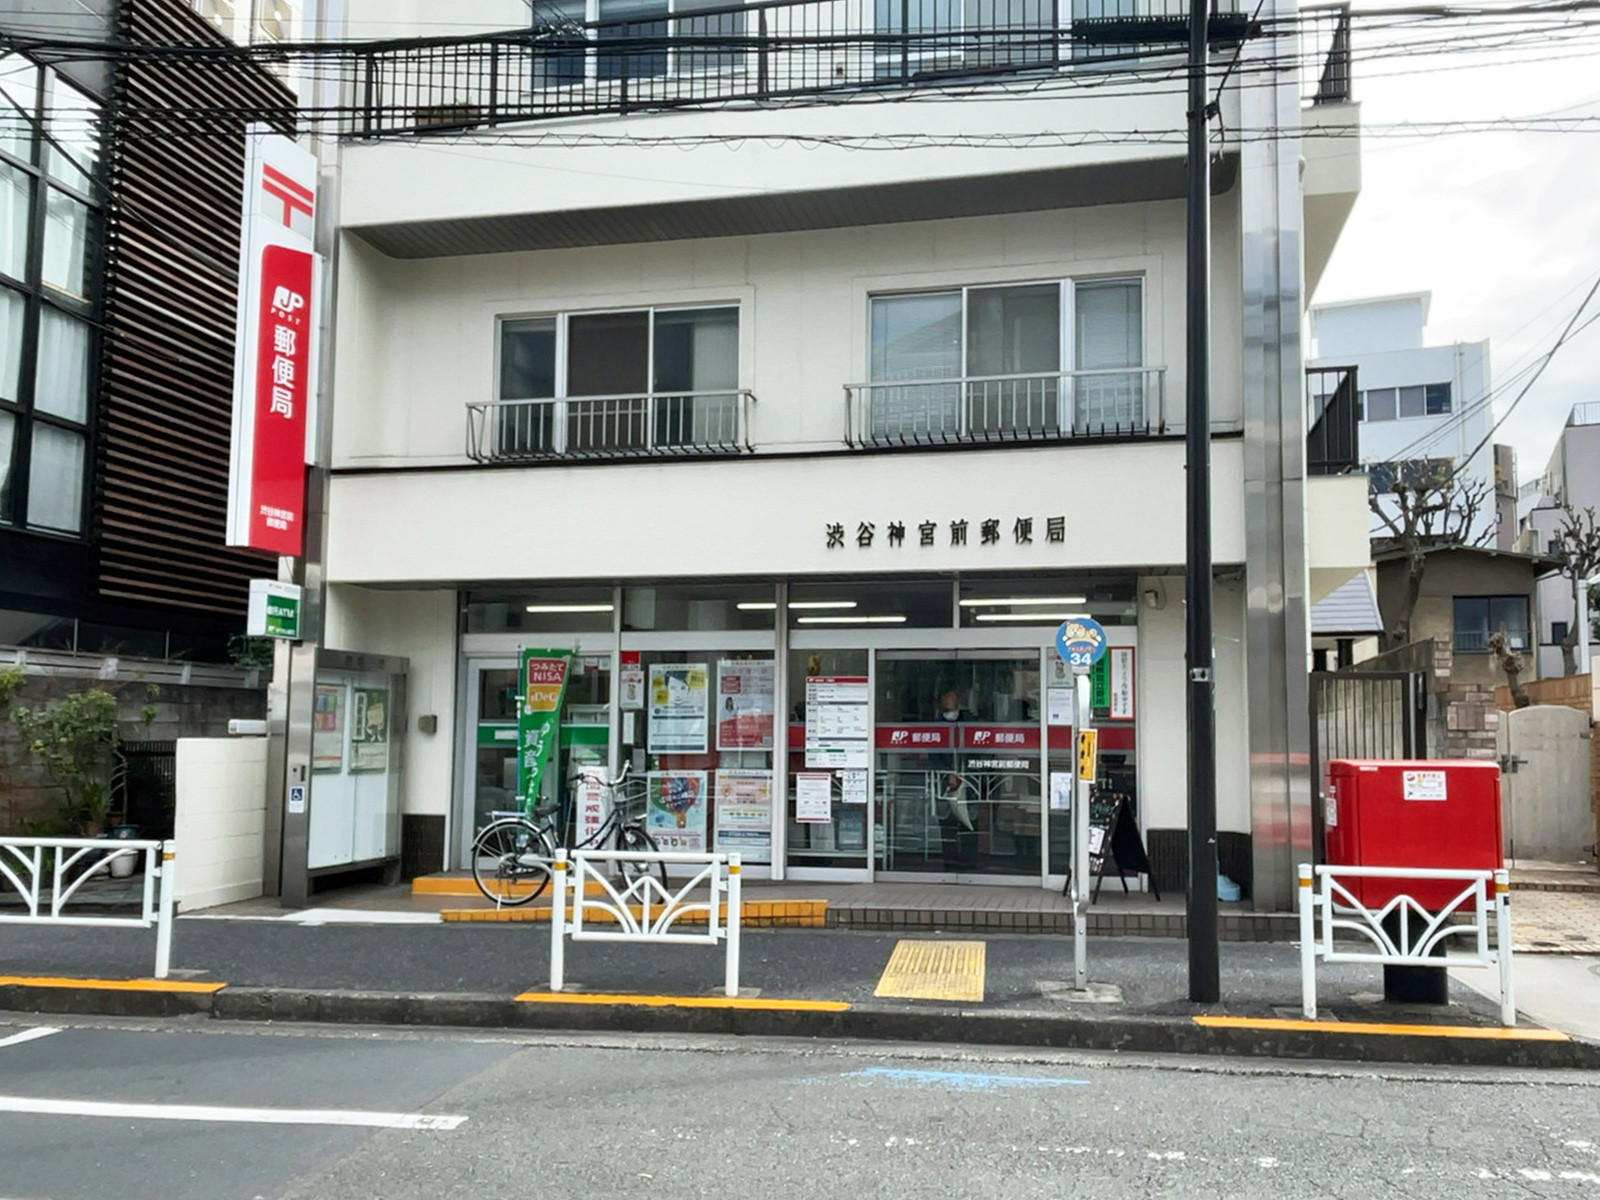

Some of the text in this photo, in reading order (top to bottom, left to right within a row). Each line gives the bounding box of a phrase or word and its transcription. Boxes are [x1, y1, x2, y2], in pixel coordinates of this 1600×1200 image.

[270, 307, 300, 325] POST
[270, 324, 296, 419] 郵便局
[826, 515, 1066, 549] 渋谷神宮前郵便局
[1069, 653, 1092, 665] 34
[531, 662, 564, 672] つみたて
[533, 671, 562, 682] NISA
[912, 732, 941, 742] 郵便局
[995, 733, 1025, 743] 郵便局
